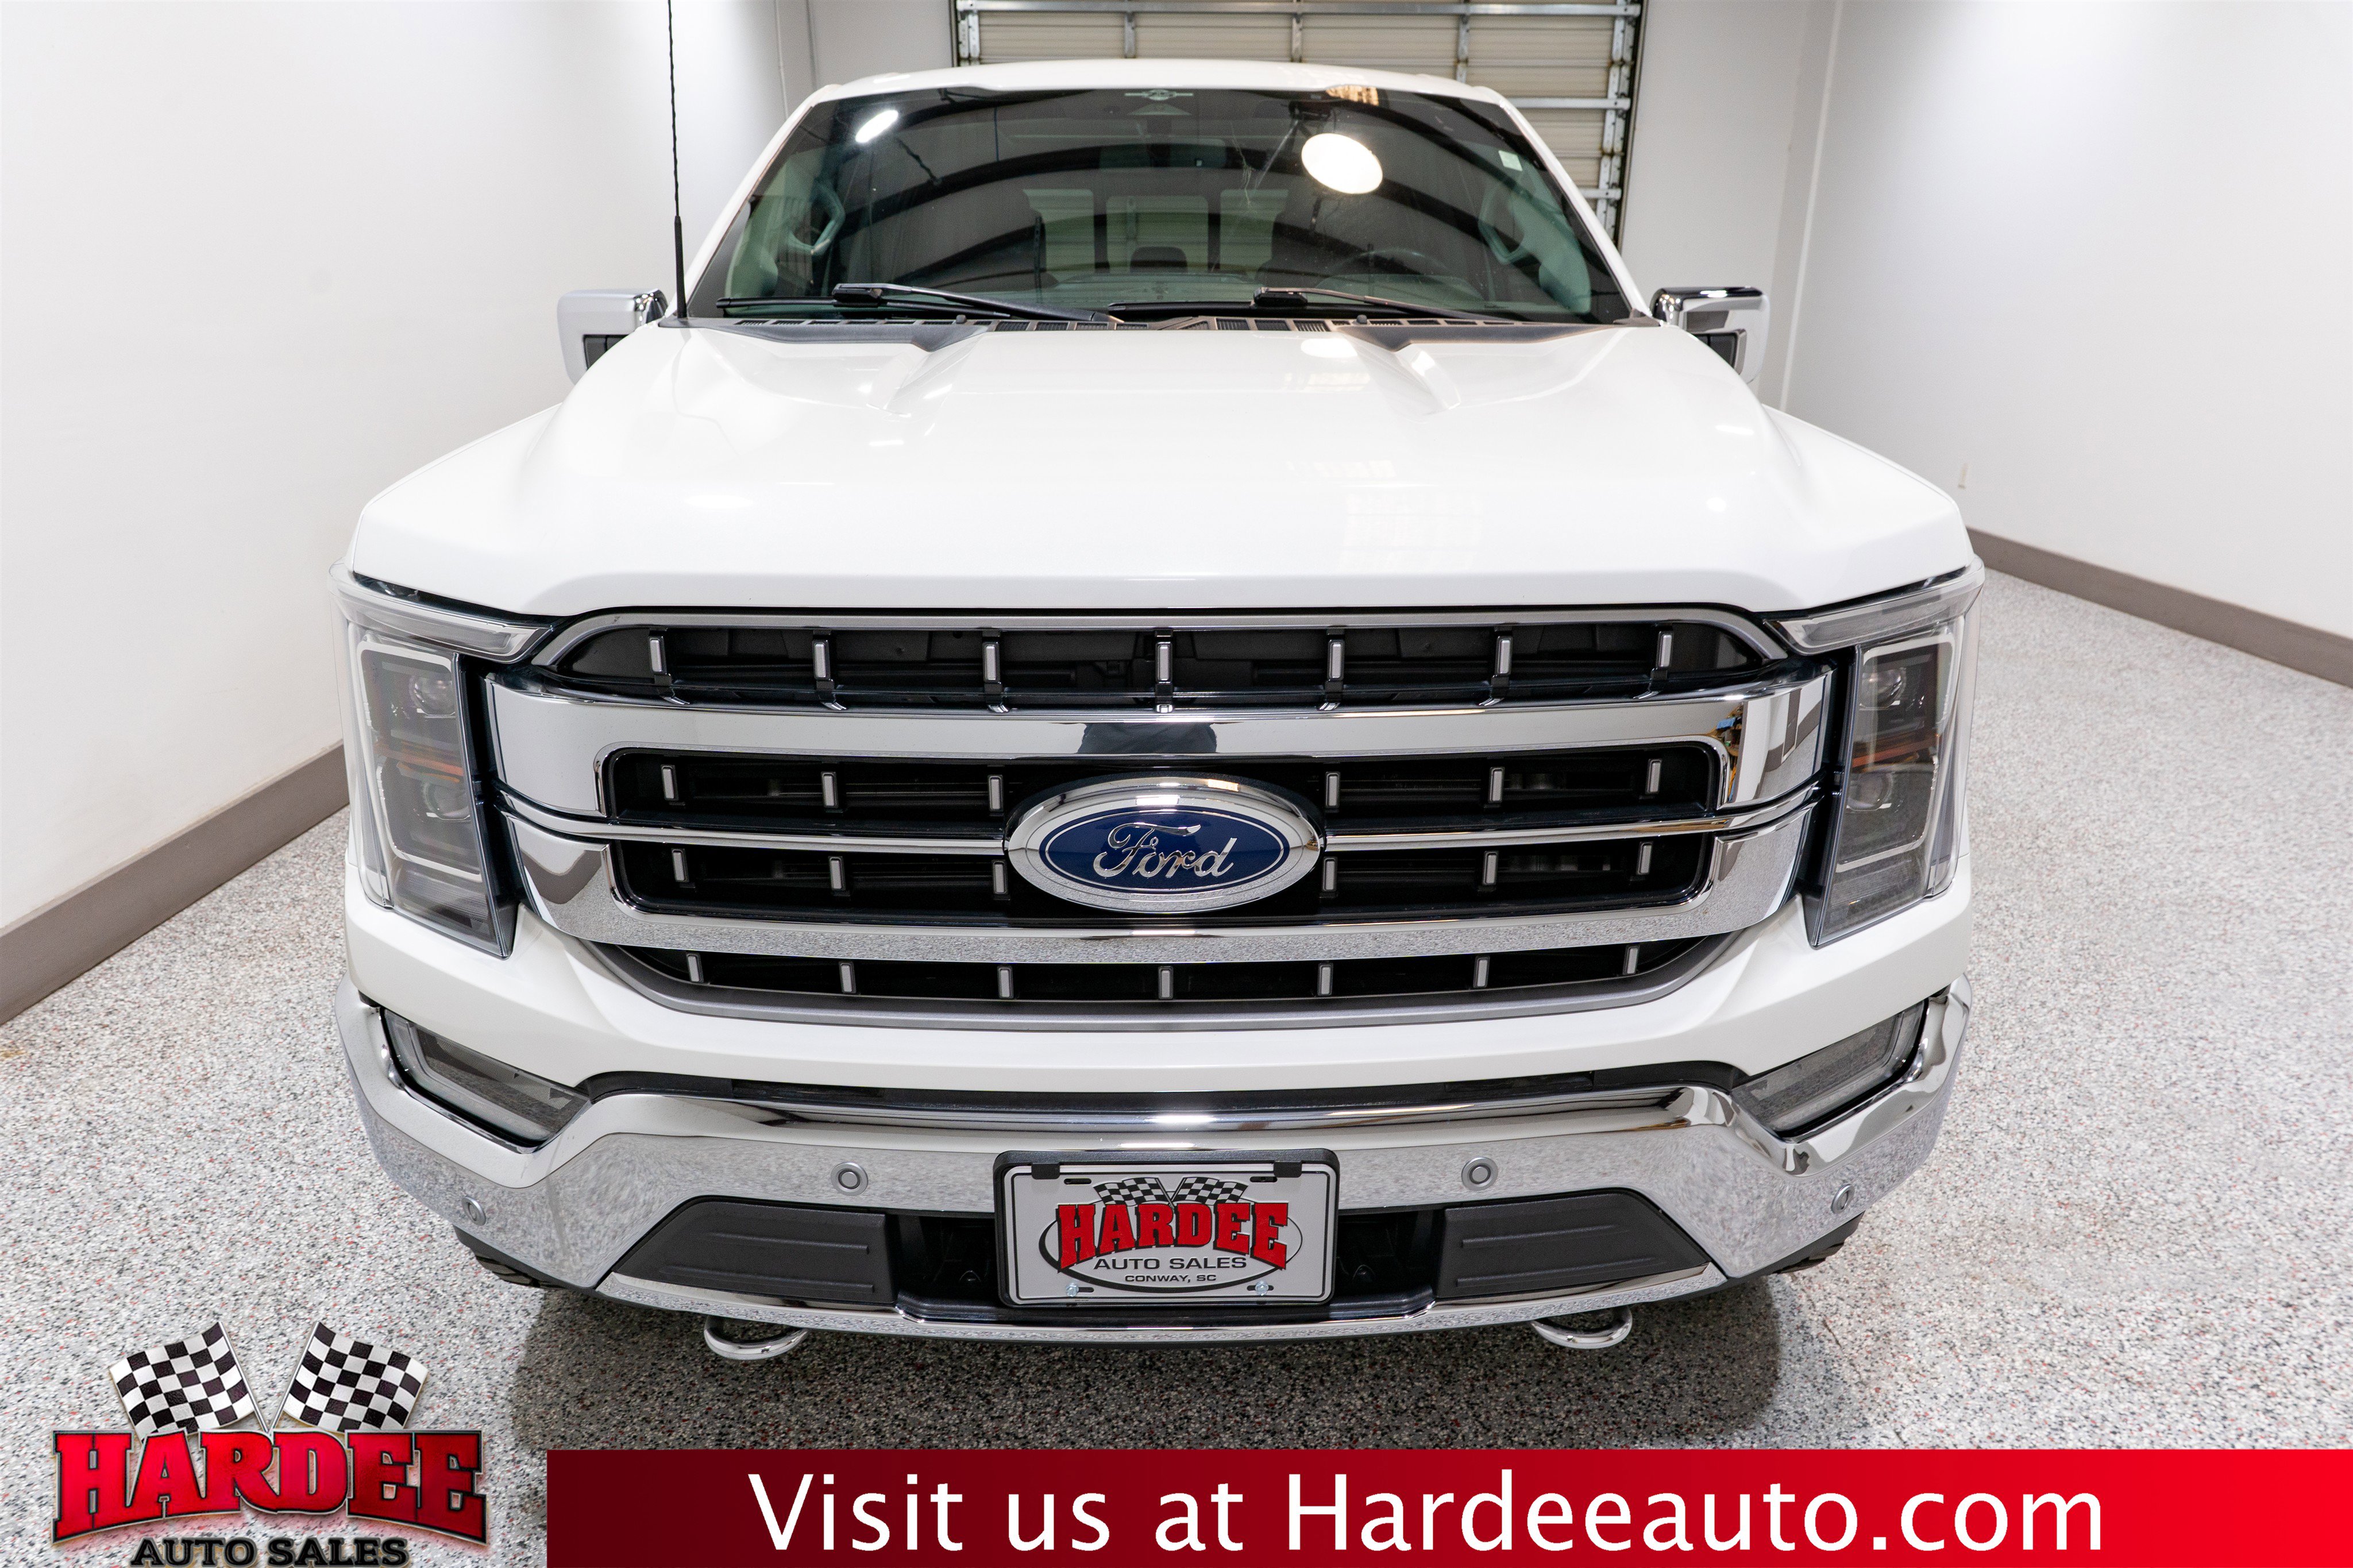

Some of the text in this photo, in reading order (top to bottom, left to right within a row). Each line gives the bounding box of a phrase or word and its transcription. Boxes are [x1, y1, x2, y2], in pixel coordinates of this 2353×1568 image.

[1093, 822, 1238, 879] Ford
[1057, 1203, 1289, 1272] HARDEE
[1093, 1257, 1248, 1270] AUTO SALES
[1125, 1274, 1217, 1283] CONWAY, SC
